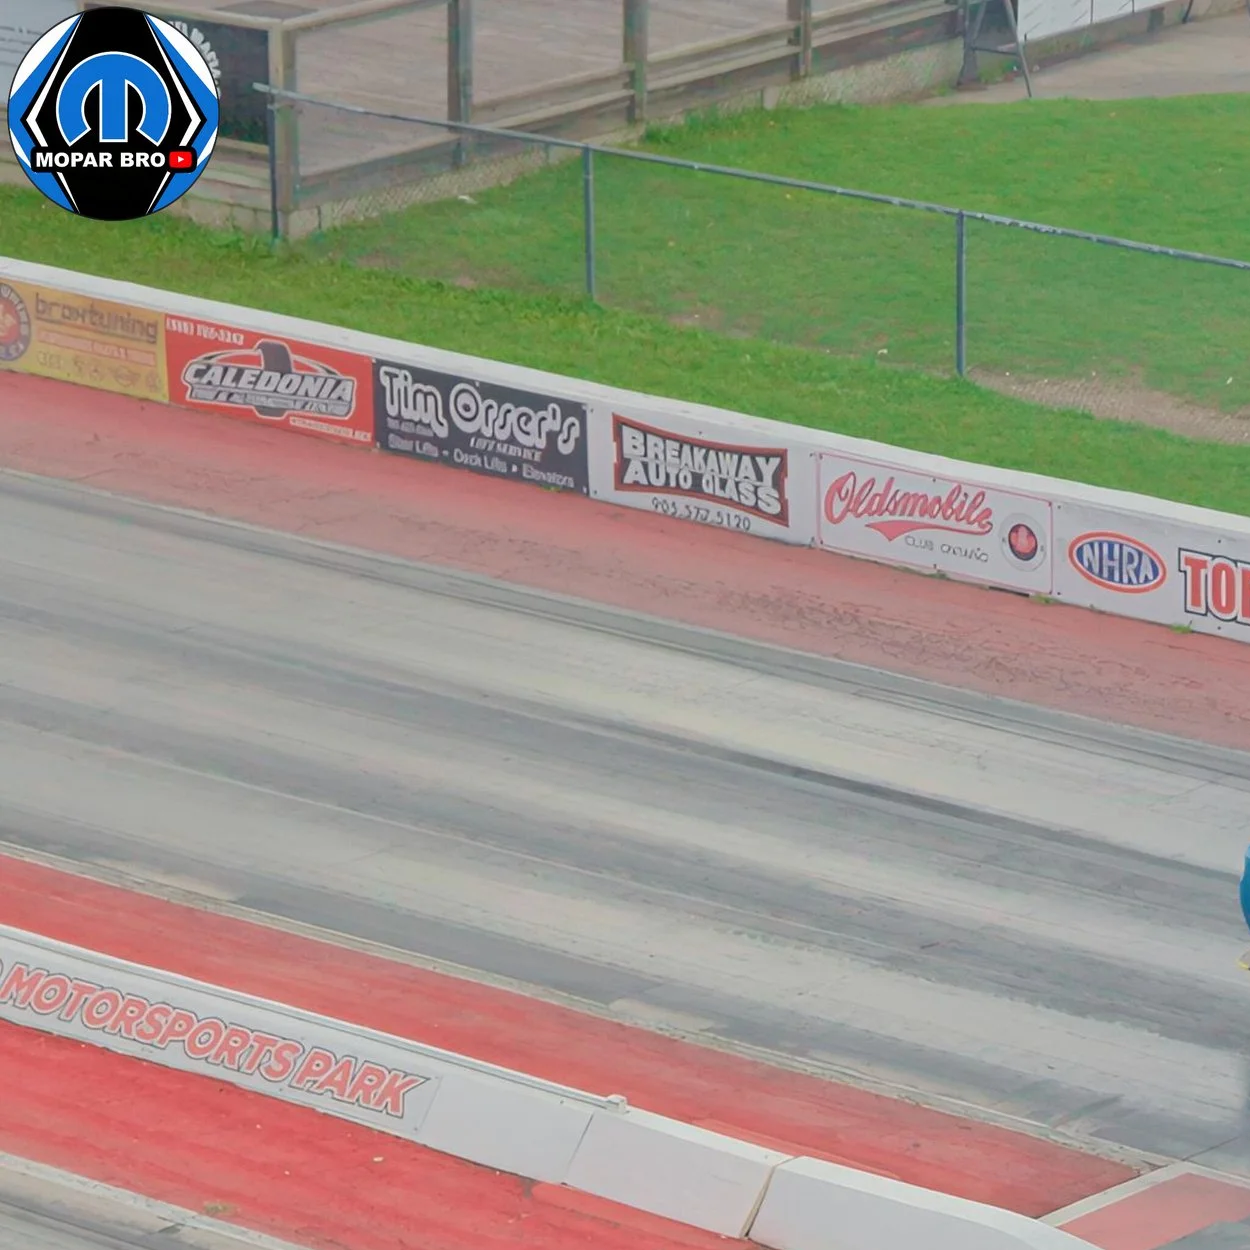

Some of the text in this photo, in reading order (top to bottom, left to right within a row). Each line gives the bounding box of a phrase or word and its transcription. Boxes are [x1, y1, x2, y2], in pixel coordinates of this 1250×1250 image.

[184, 363, 355, 401] CALEDONIA
[380, 366, 449, 438] Tim
[622, 424, 781, 486] BREAKAWAY
[623, 458, 782, 515] AUTO GLASS
[824, 471, 993, 530] Oldsmobile
[1081, 541, 1159, 586] NHRA
[0, 962, 429, 1118] MOTORSPORTS PARK
